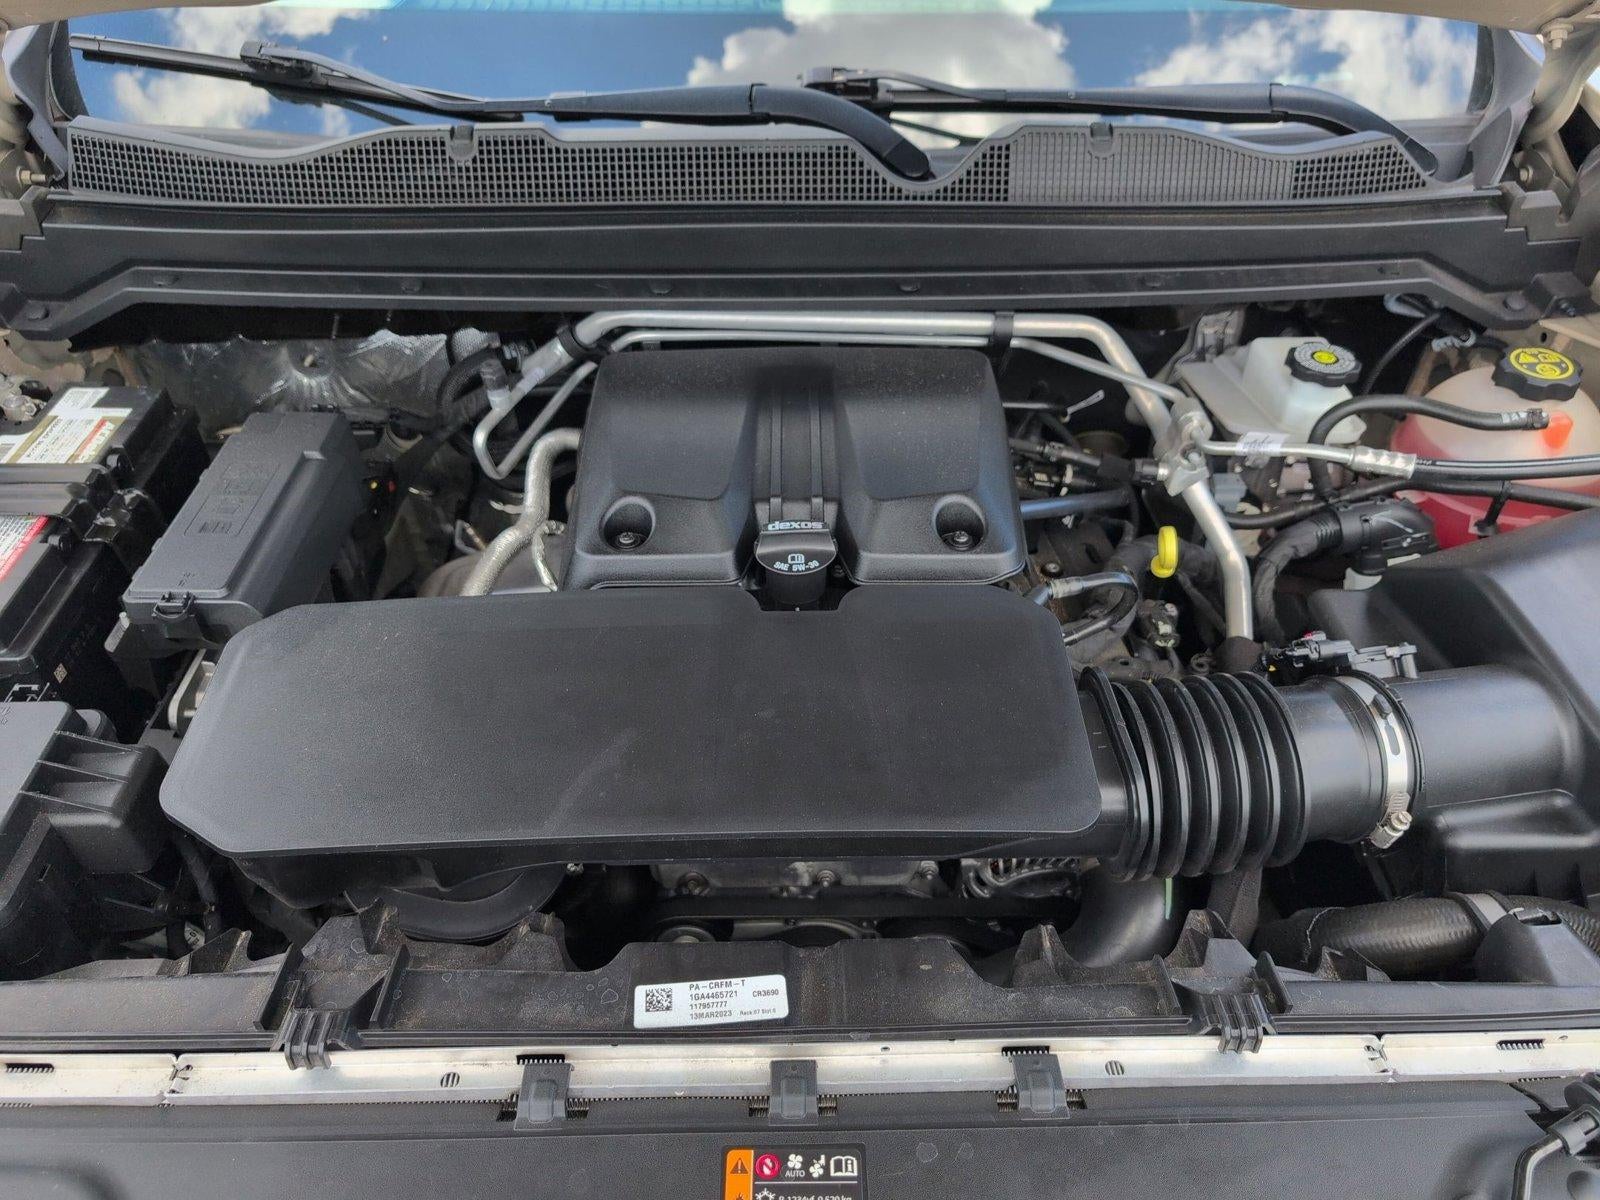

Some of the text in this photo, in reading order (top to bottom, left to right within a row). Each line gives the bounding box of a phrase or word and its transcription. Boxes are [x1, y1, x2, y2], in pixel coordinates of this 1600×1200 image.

[767, 521, 824, 531] dexos
[773, 560, 820, 572] SAE 5W-30
[752, 989, 779, 998] CR3690
[690, 1010, 733, 1020] 13MAR2023
[785, 1169, 806, 1178] AUTO
